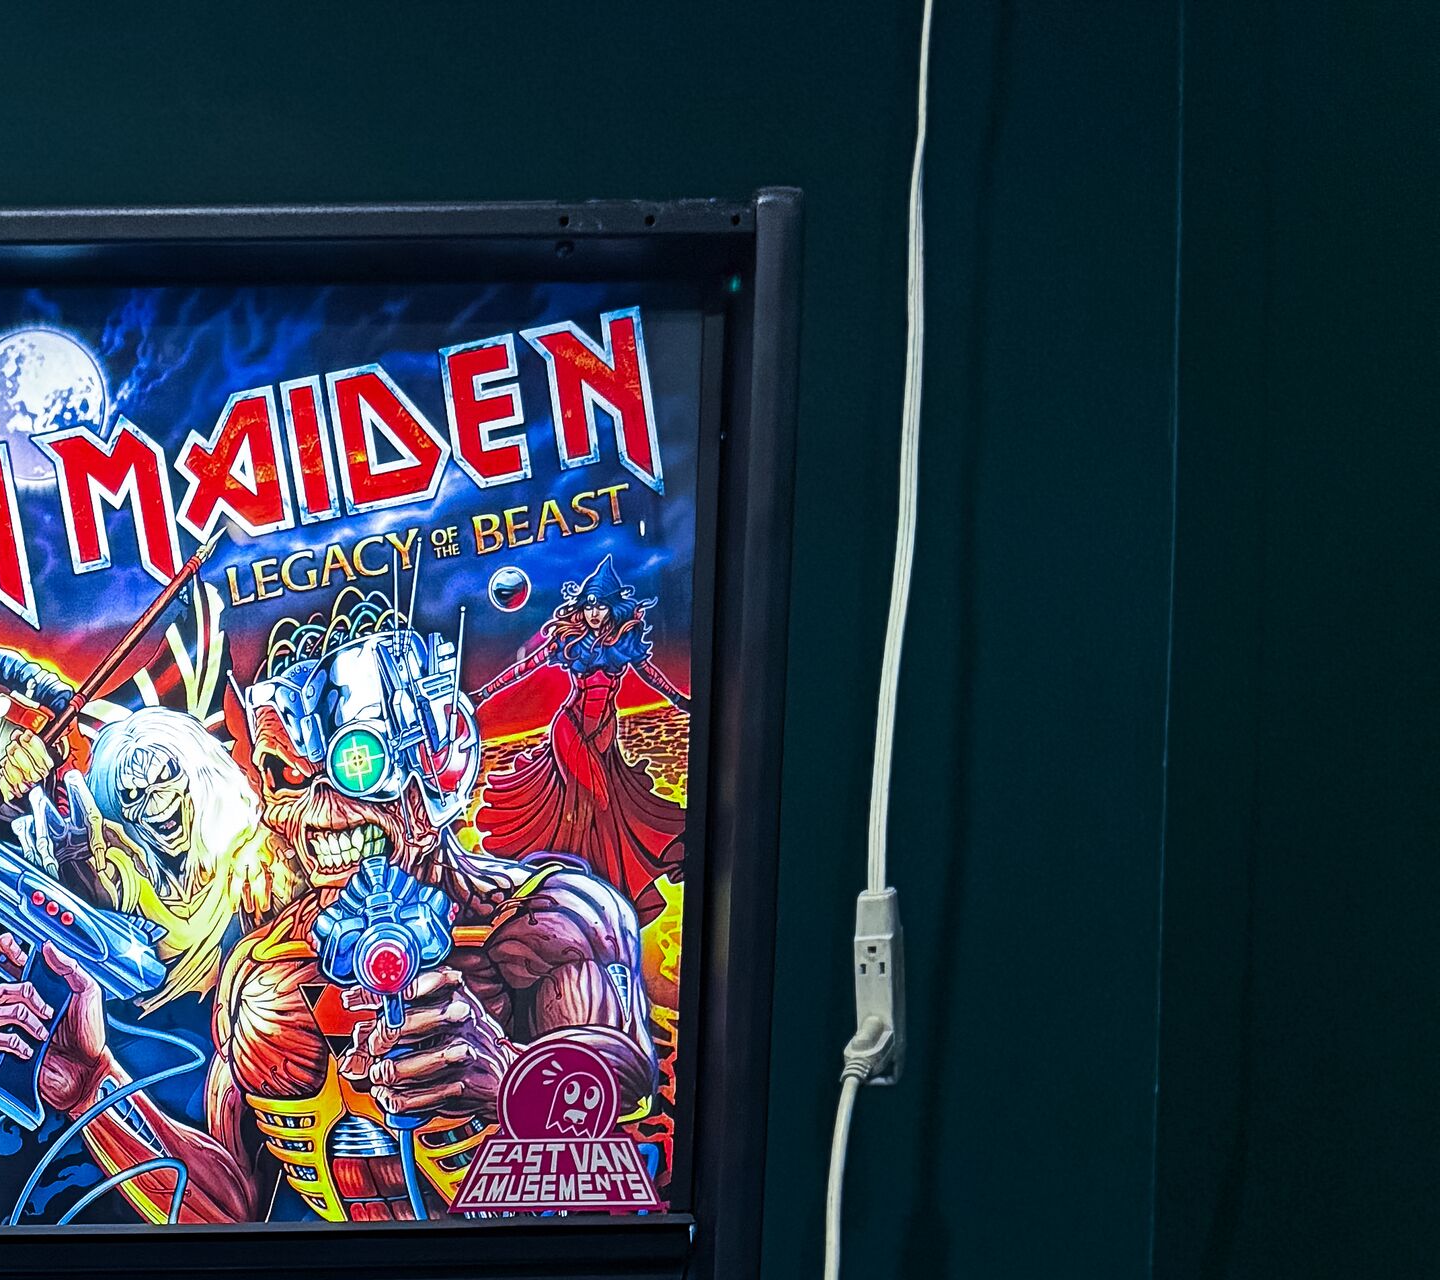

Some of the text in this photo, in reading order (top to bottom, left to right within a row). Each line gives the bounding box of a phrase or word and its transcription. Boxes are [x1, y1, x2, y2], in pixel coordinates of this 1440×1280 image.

[32, 305, 665, 585] MAIDEN
[228, 482, 631, 606] LEGACY OF BEAST
[435, 540, 461, 558] THE
[480, 1142, 636, 1174] EAST VAN
[465, 1173, 649, 1202] AMUSEMENTS
